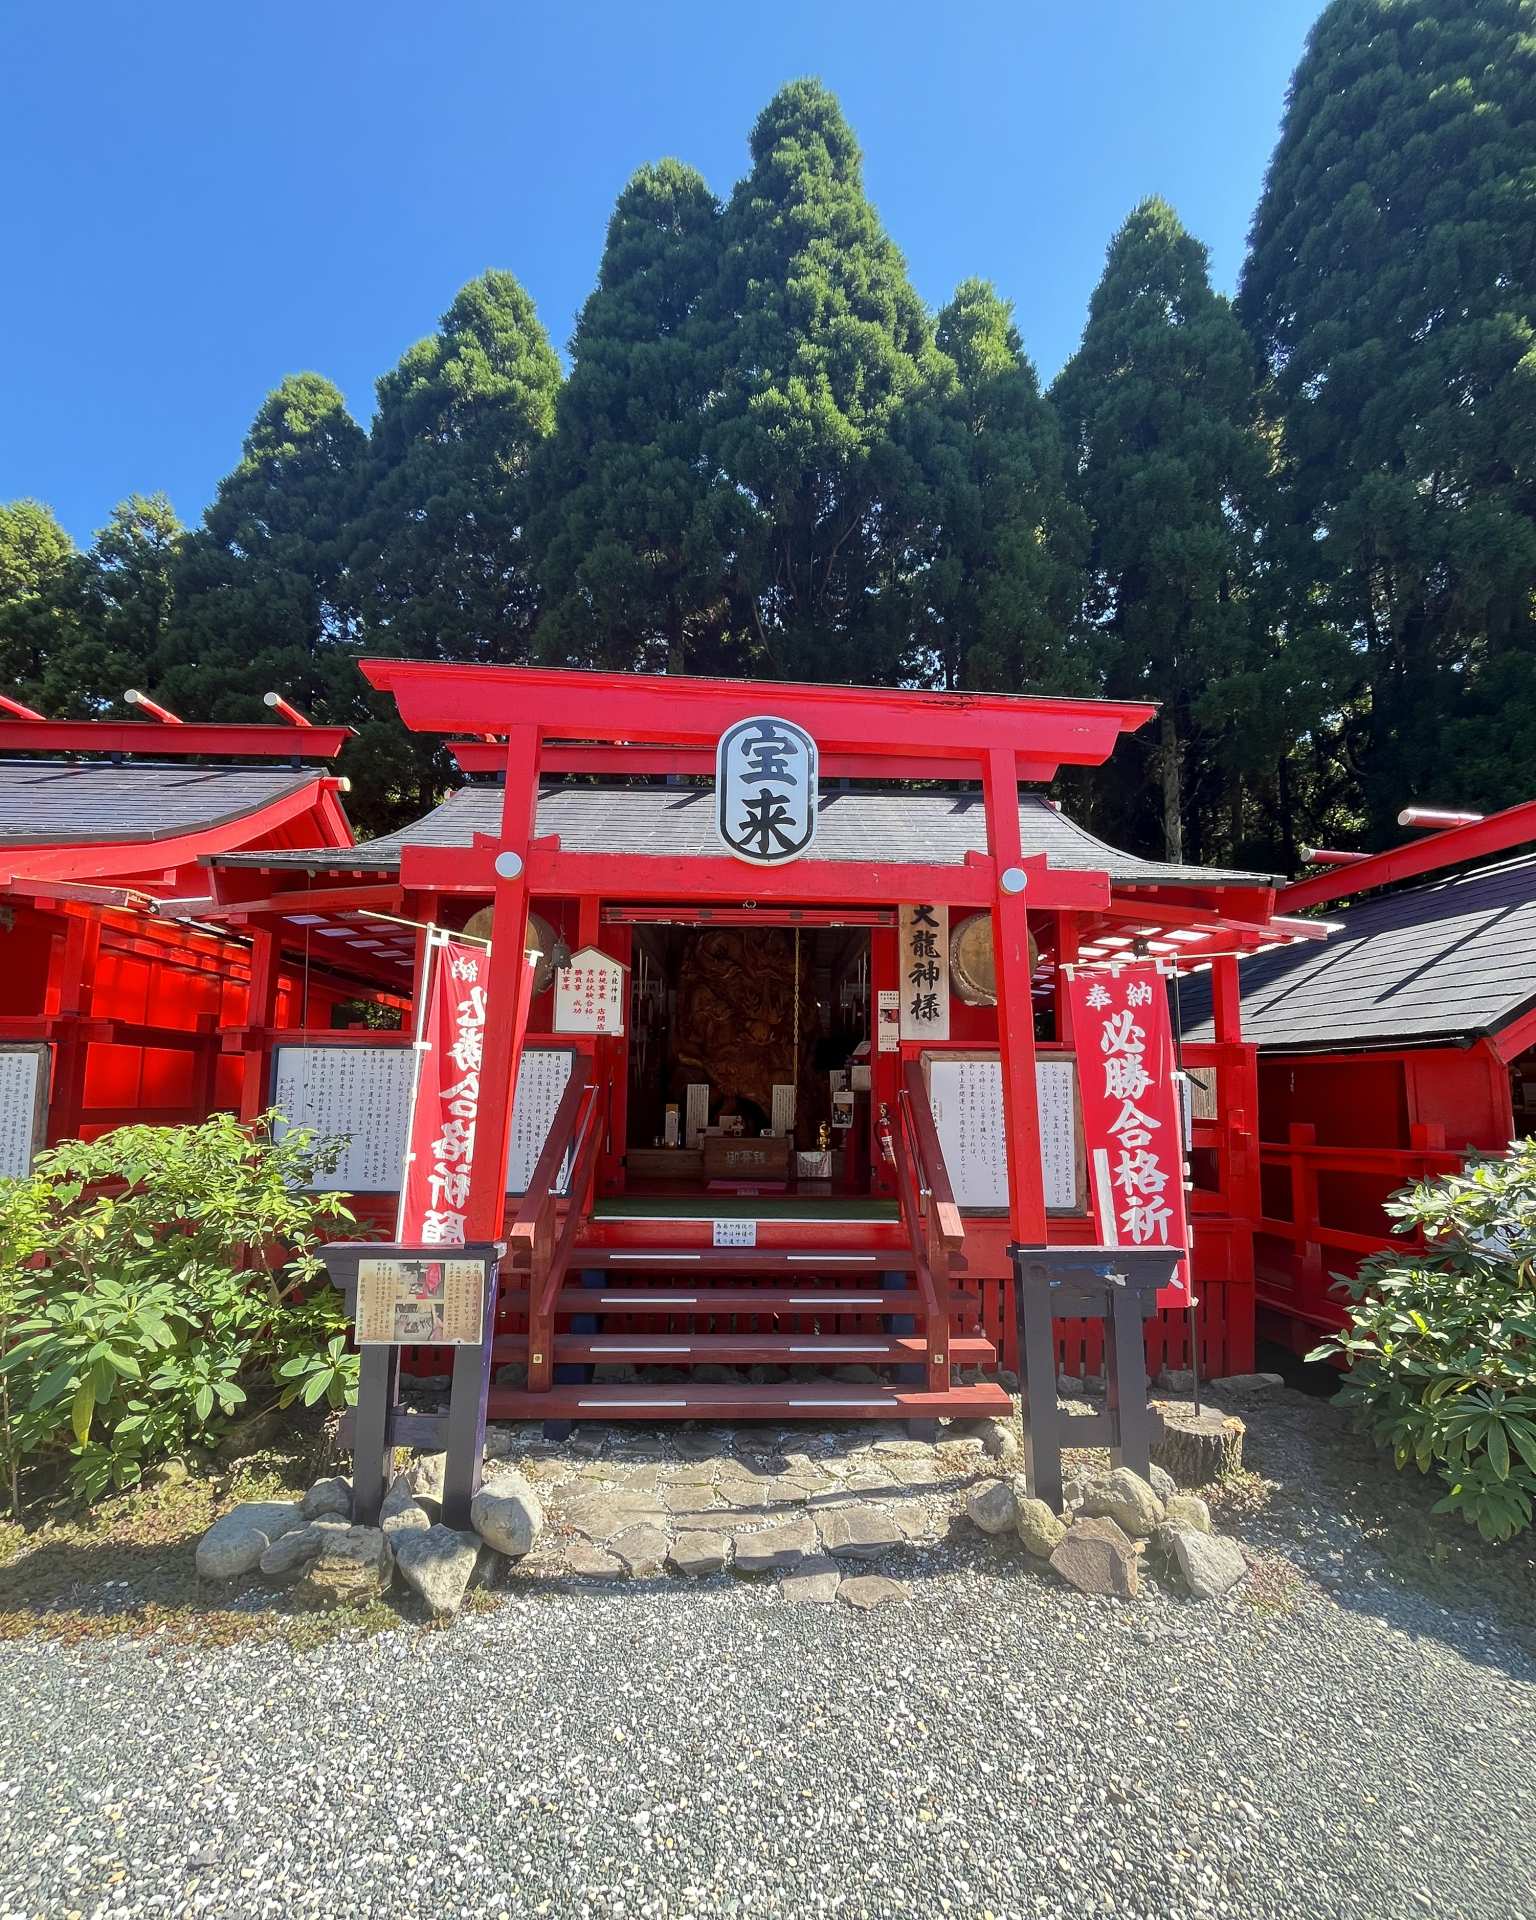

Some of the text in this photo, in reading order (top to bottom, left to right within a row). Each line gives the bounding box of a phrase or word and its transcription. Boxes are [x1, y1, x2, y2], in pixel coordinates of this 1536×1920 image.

[738, 724, 798, 854] 宝来
[908, 904, 941, 1021] 大龍神様
[1086, 981, 1153, 1011] 奉納
[1100, 1009, 1184, 1289] 必勝合格祈
